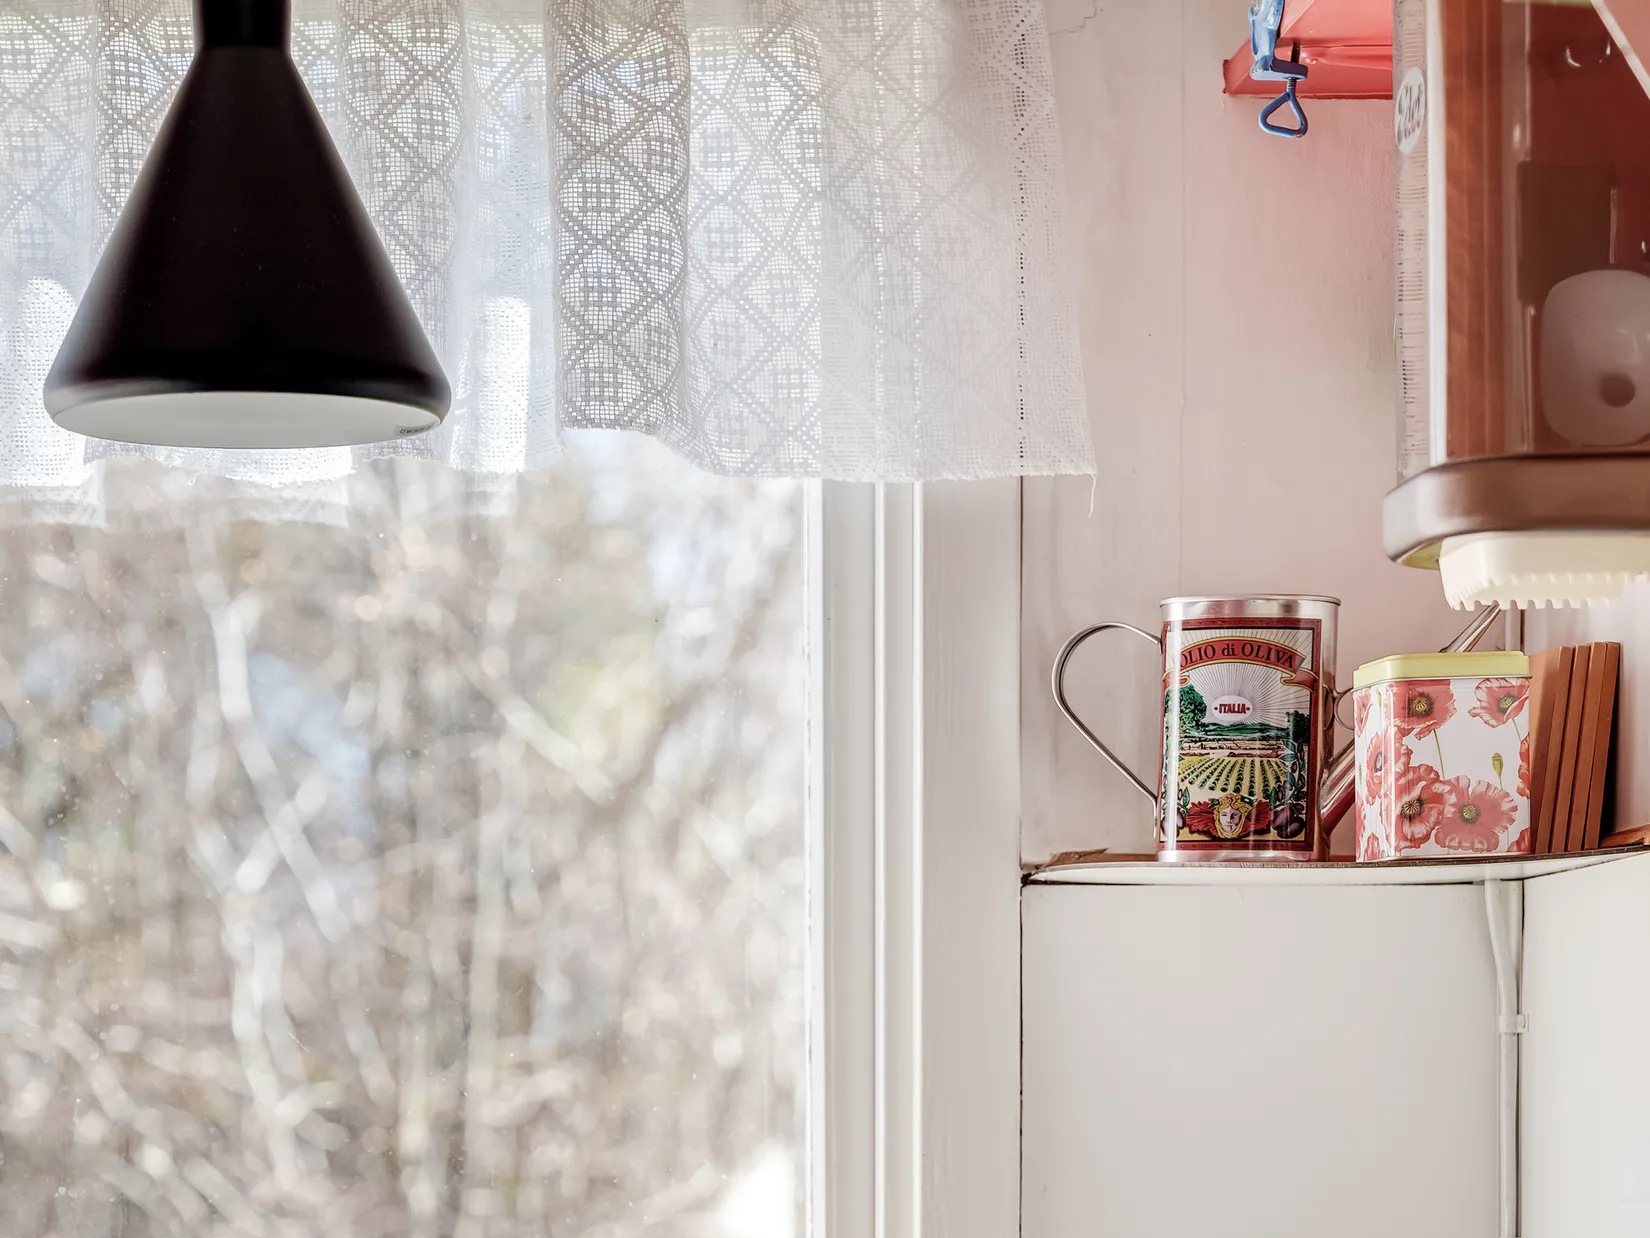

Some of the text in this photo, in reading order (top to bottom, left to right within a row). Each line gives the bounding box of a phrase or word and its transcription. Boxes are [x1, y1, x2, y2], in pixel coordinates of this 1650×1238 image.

[1221, 643, 1237, 657] di
[1241, 642, 1293, 669] OLIVA
[1219, 704, 1247, 714] ITALIA
